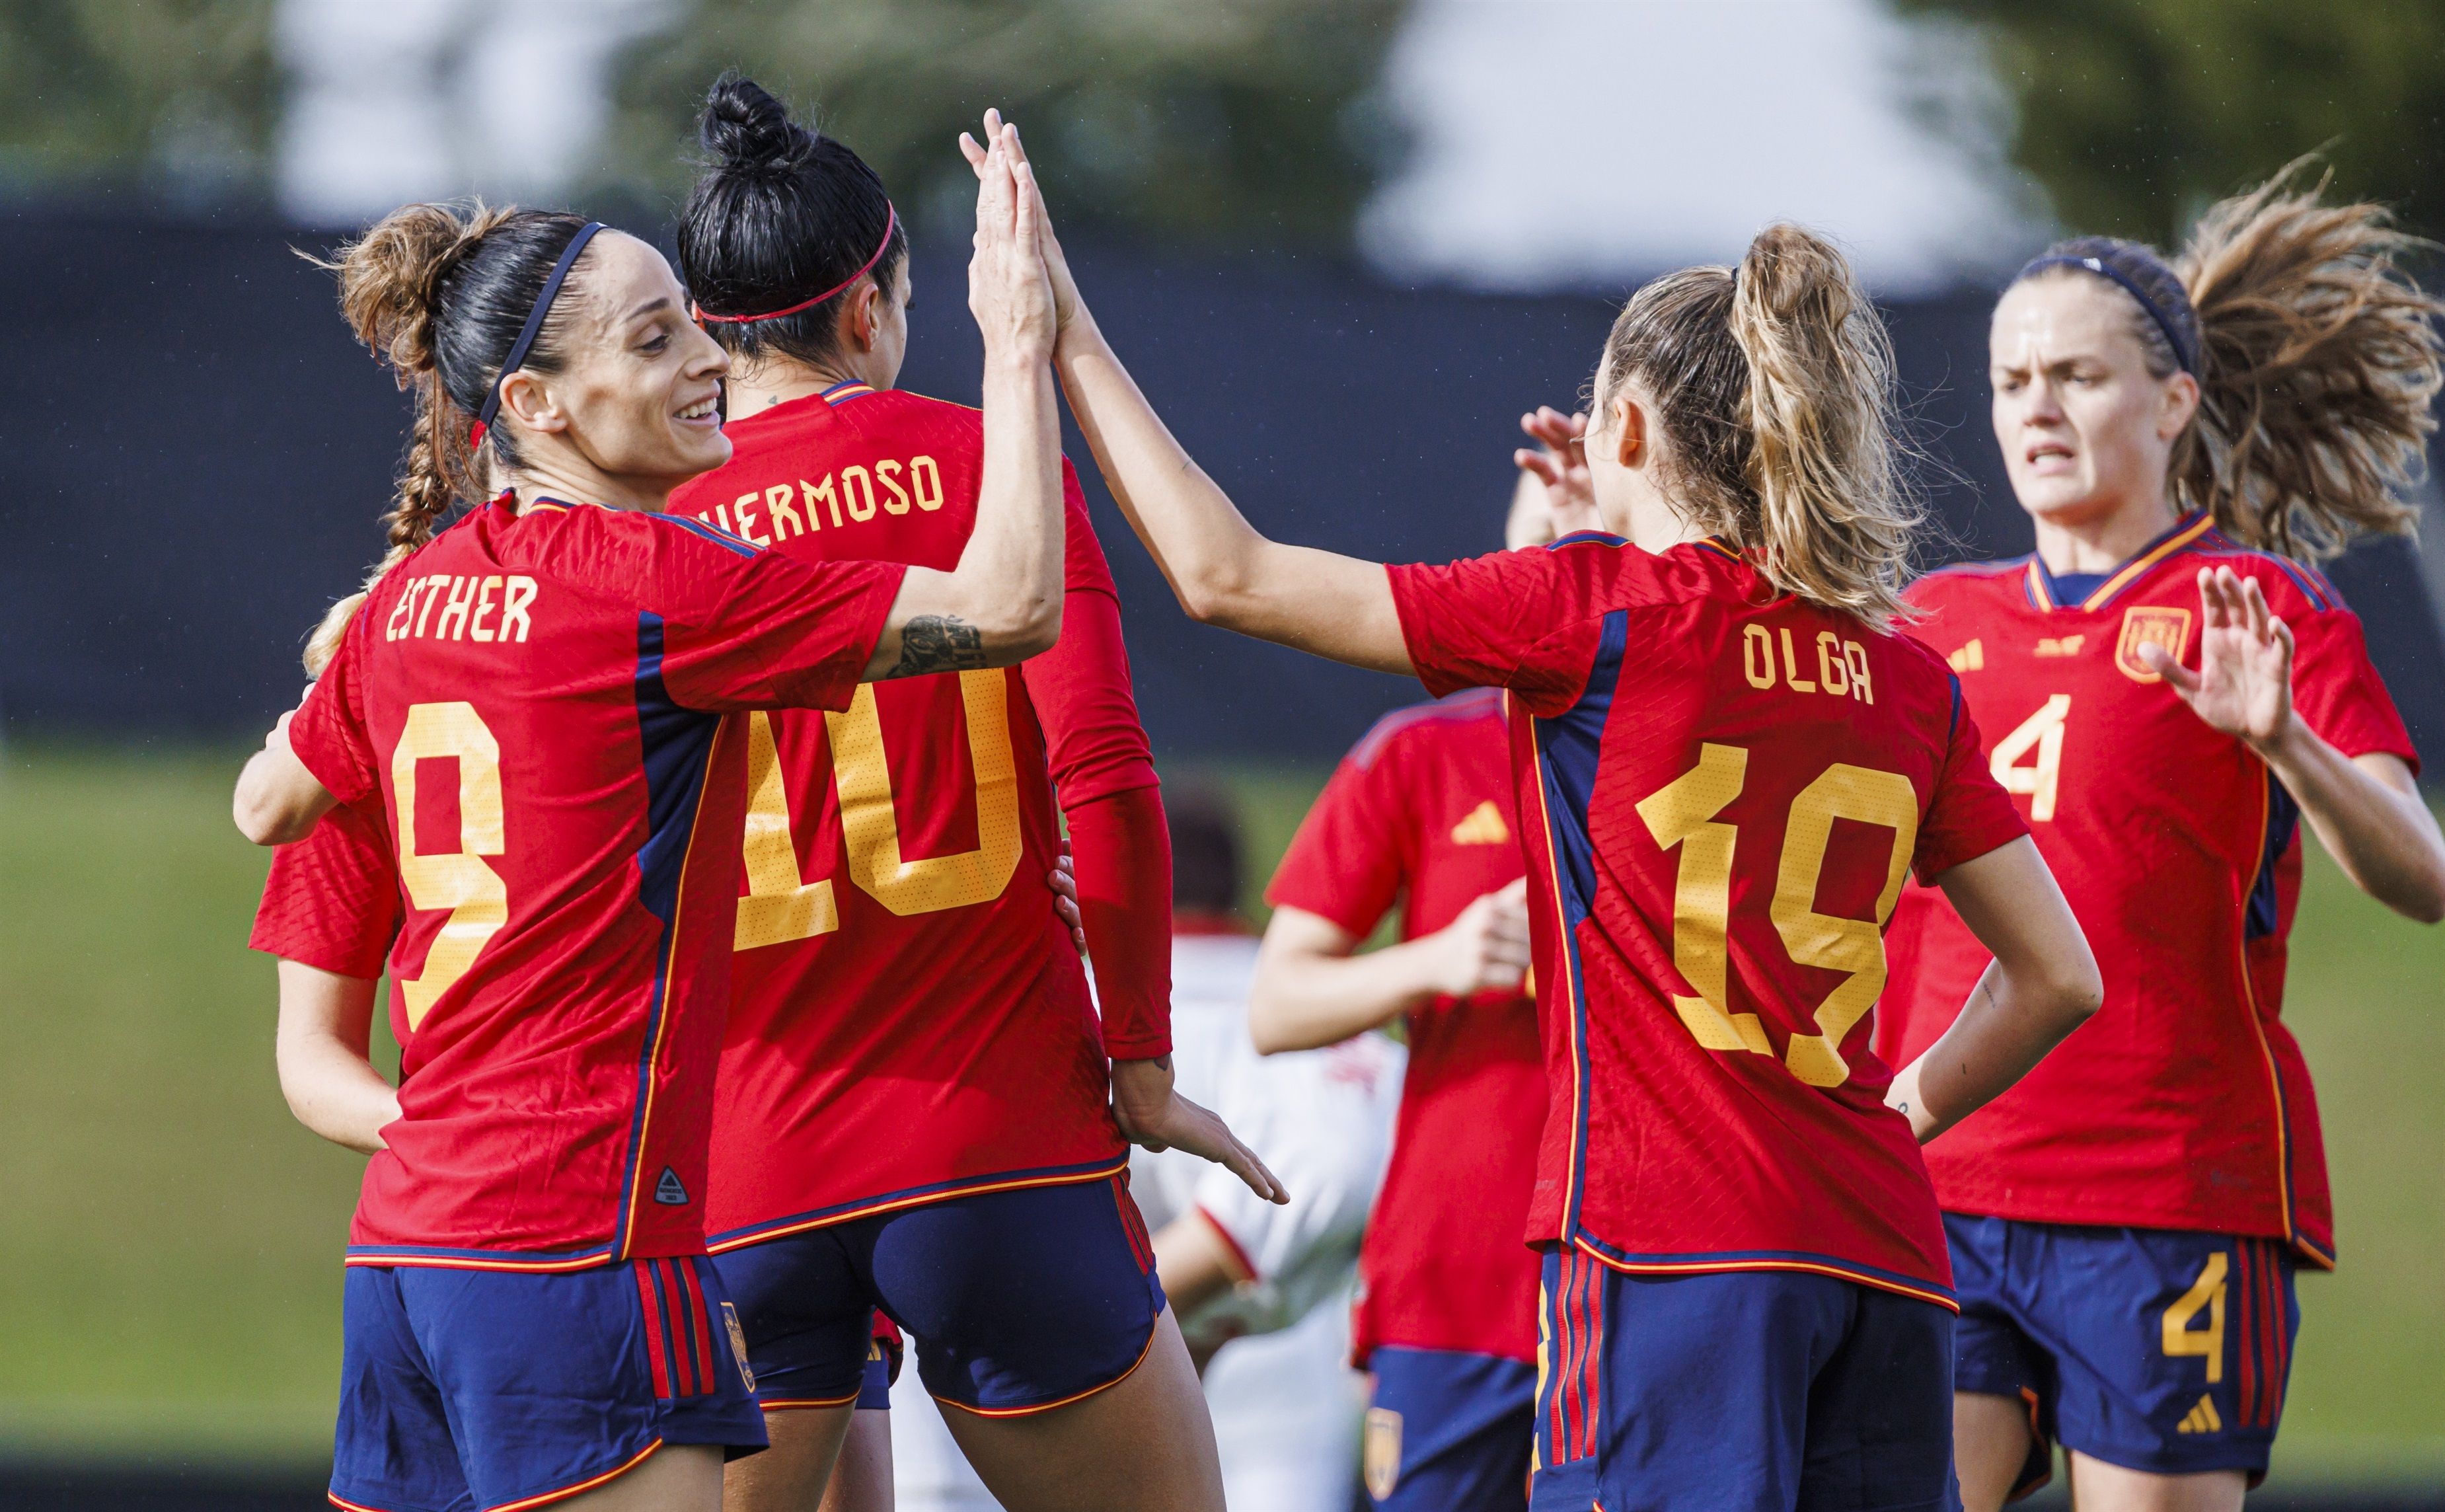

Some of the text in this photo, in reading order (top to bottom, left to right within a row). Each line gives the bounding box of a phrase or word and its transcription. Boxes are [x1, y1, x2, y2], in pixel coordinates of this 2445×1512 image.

[386, 575, 538, 642] ESTHER
[1743, 623, 1874, 705] OLGA
[733, 667, 1022, 952] 10
[1990, 694, 2071, 821] 4
[392, 701, 508, 1033] 9
[1635, 742, 1918, 1088] 19
[2162, 1252, 2228, 1384] 4
